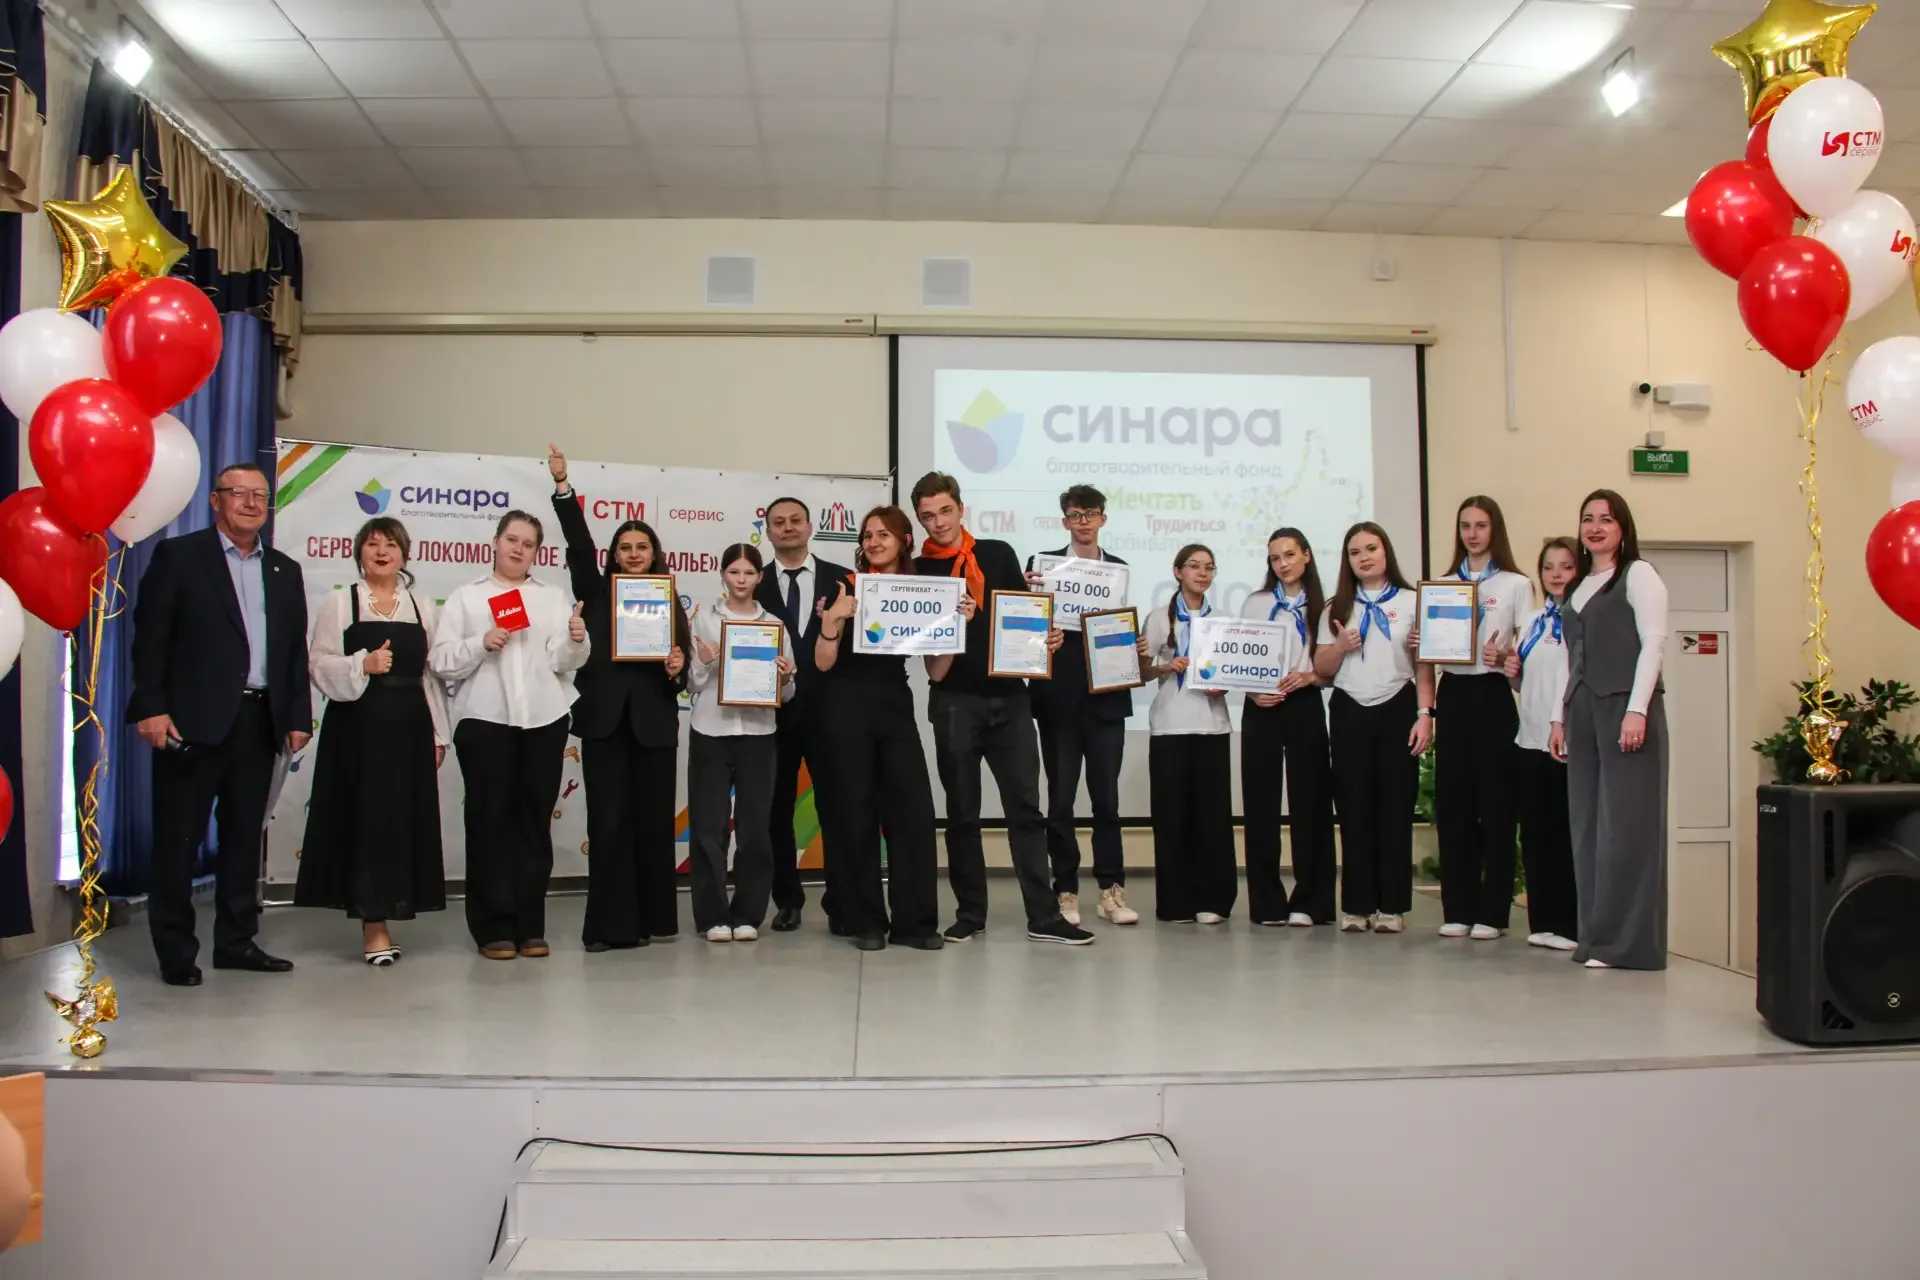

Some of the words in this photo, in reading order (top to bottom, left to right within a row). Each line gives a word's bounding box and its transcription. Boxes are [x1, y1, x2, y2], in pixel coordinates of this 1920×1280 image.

[1853, 131, 1882, 147] СТМ
[1043, 404, 1282, 457] синара
[1046, 457, 1230, 476] благотворительный
[1234, 459, 1284, 478] фонд
[400, 485, 510, 512] синара
[400, 508, 485, 521] благотворительный
[593, 499, 645, 521] СТМ
[669, 507, 725, 523] сервис
[978, 510, 1016, 533] СТМ
[1144, 514, 1226, 535] Трудиться
[1055, 580, 1081, 594] 150
[1084, 584, 1111, 599] 000
[880, 599, 909, 613] 200
[913, 601, 942, 615] 000
[1213, 641, 1238, 654] 100
[1242, 643, 1269, 656] 000
[1221, 664, 1279, 680] синара
